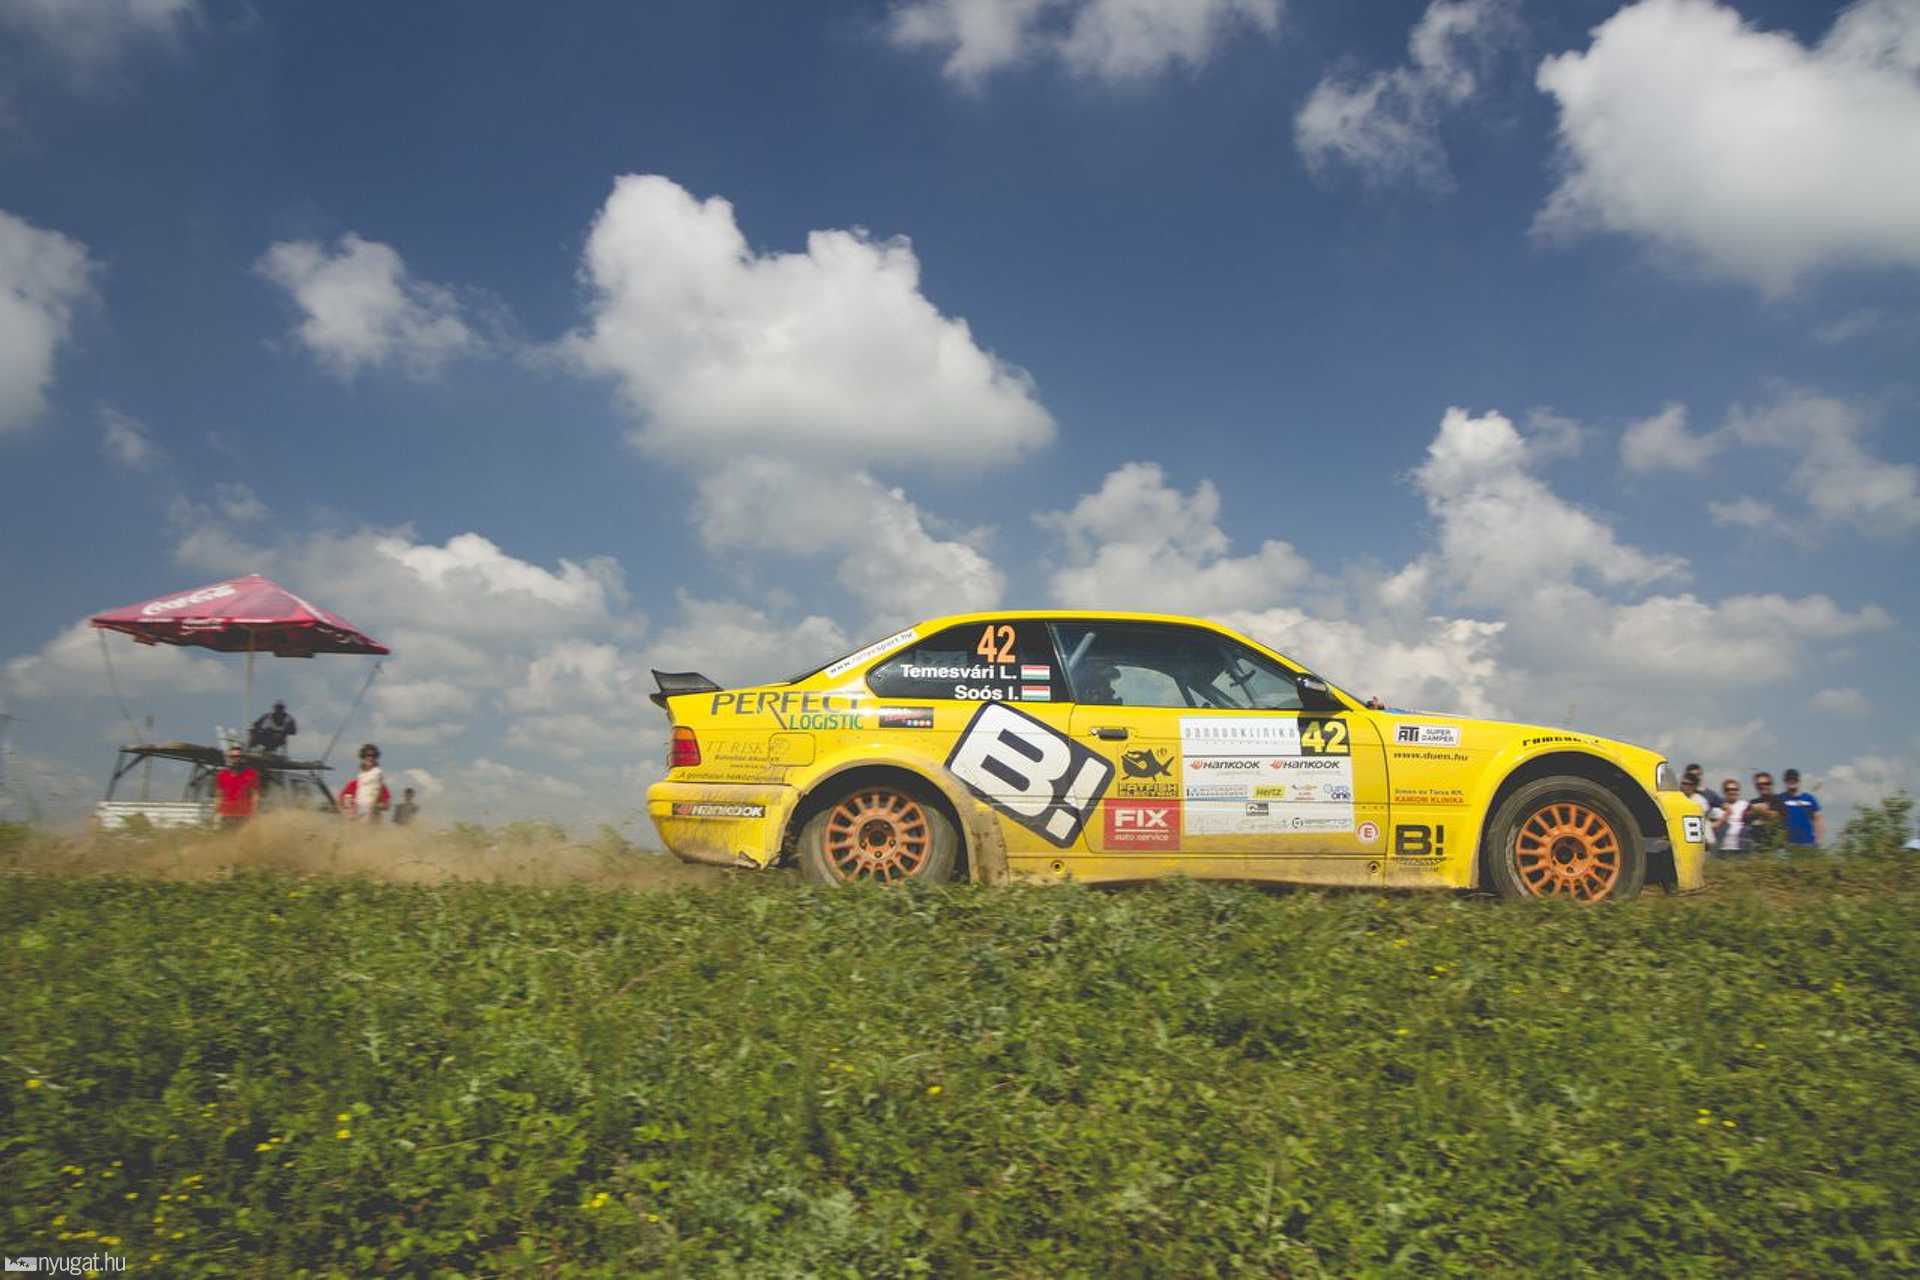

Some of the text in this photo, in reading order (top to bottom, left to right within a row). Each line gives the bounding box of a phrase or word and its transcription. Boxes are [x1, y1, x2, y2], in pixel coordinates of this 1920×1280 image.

[977, 625, 1016, 663] 42
[900, 664, 1017, 679] Temesvári L.
[954, 685, 1019, 700] Soós I.
[711, 690, 865, 729] PERFECT
[789, 714, 864, 730] LOGISTIC
[1301, 720, 1349, 753] 42
[950, 703, 1109, 840] B!
[1115, 809, 1169, 828] FIX
[1395, 824, 1444, 856] B!
